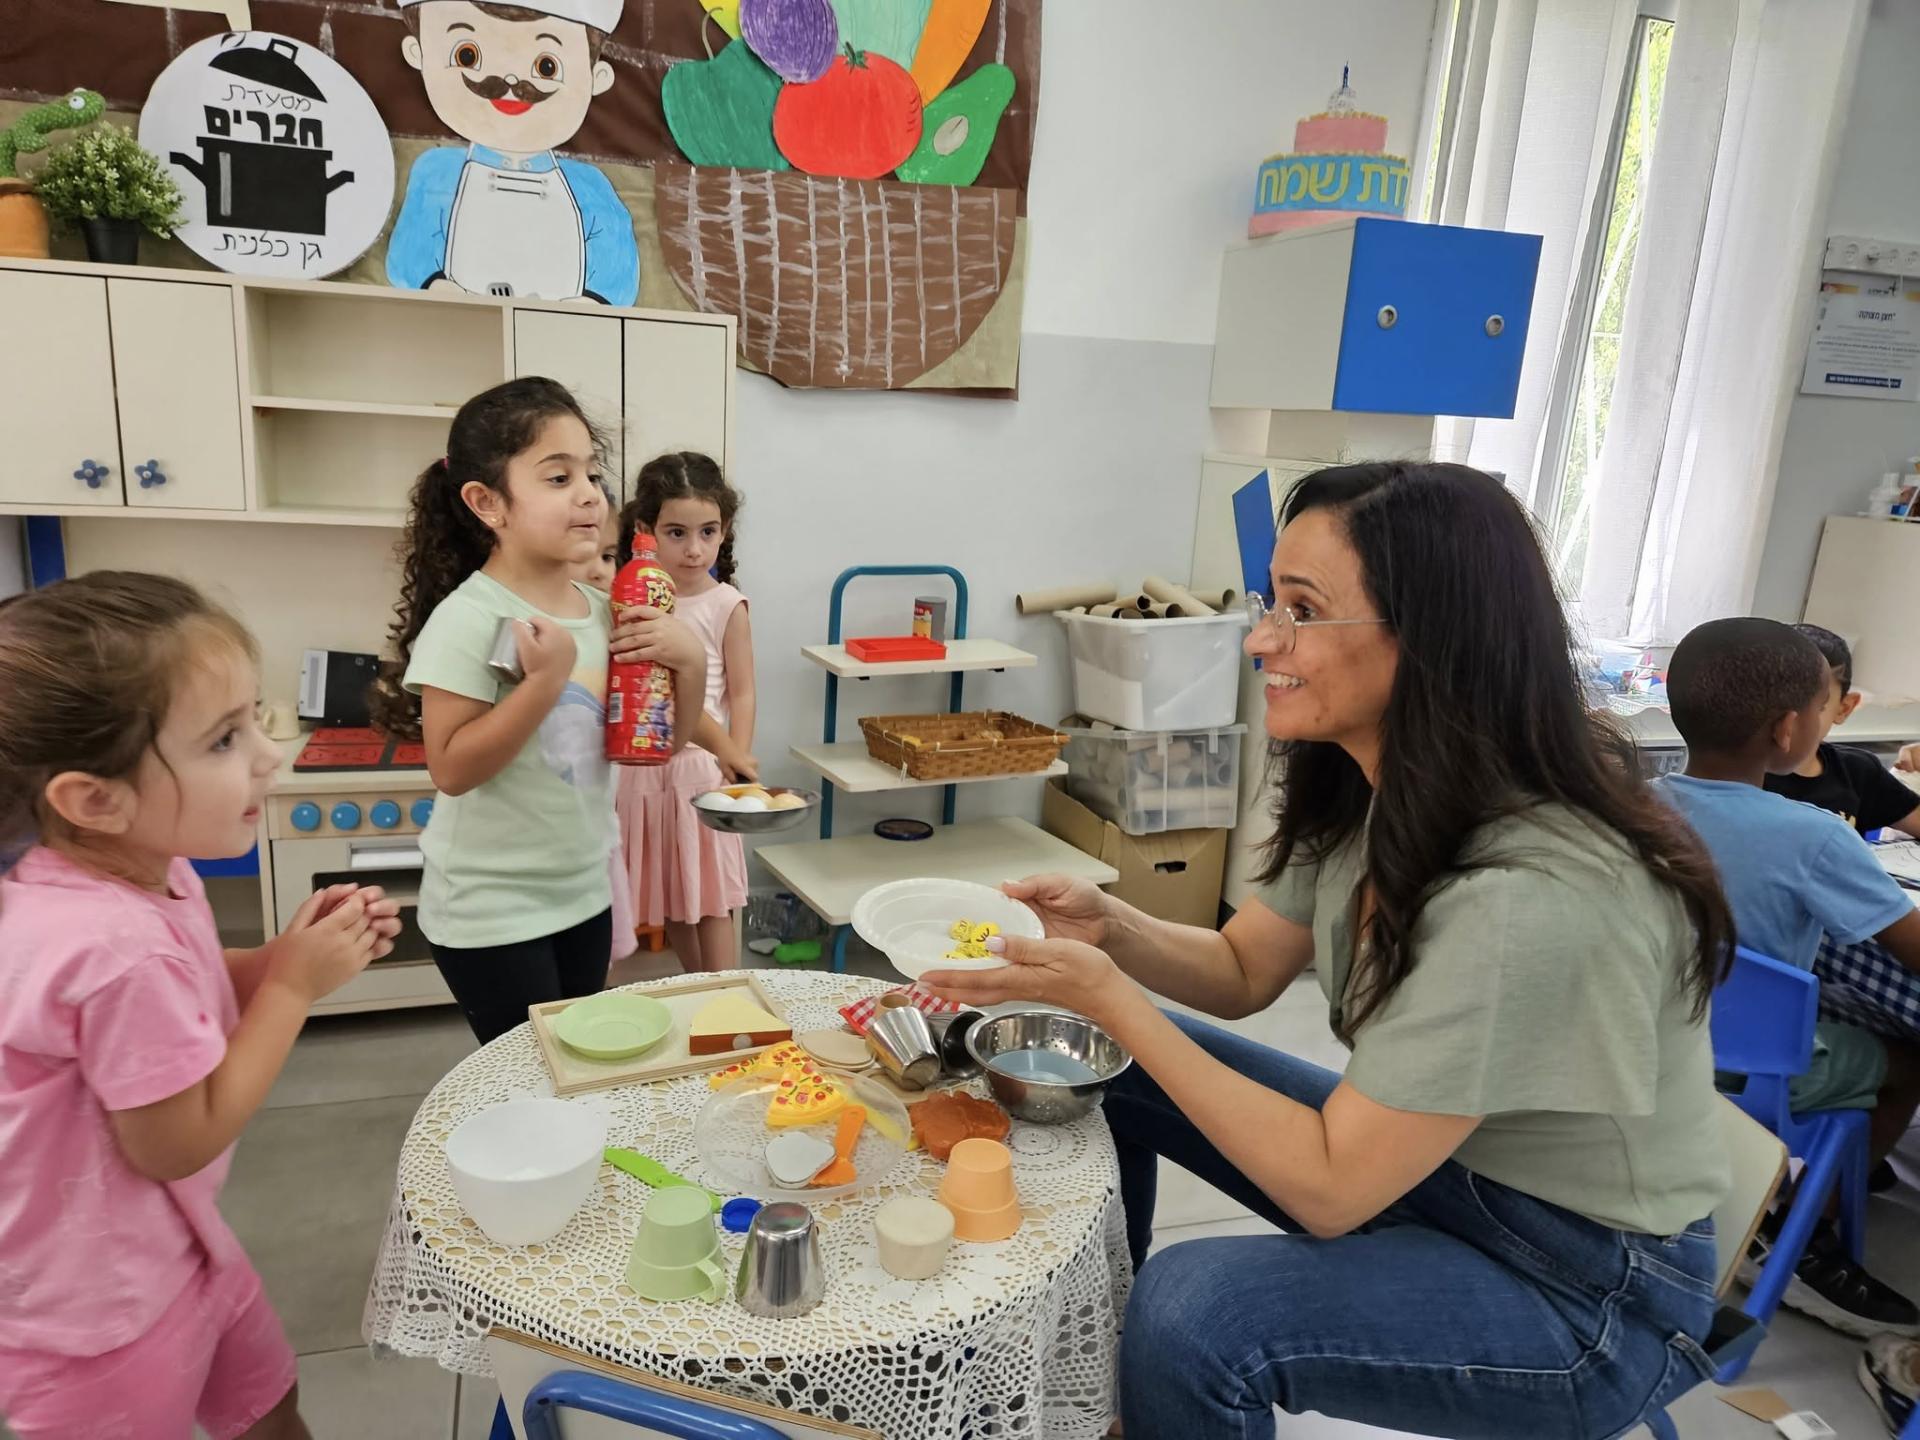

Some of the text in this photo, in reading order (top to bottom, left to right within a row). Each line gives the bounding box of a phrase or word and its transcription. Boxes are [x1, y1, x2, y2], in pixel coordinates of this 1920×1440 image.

[221, 84, 312, 112] מסעדת
[203, 104, 323, 148] חברים
[1259, 162, 1410, 207] דת שמח
[213, 230, 322, 270] גן כלנית
